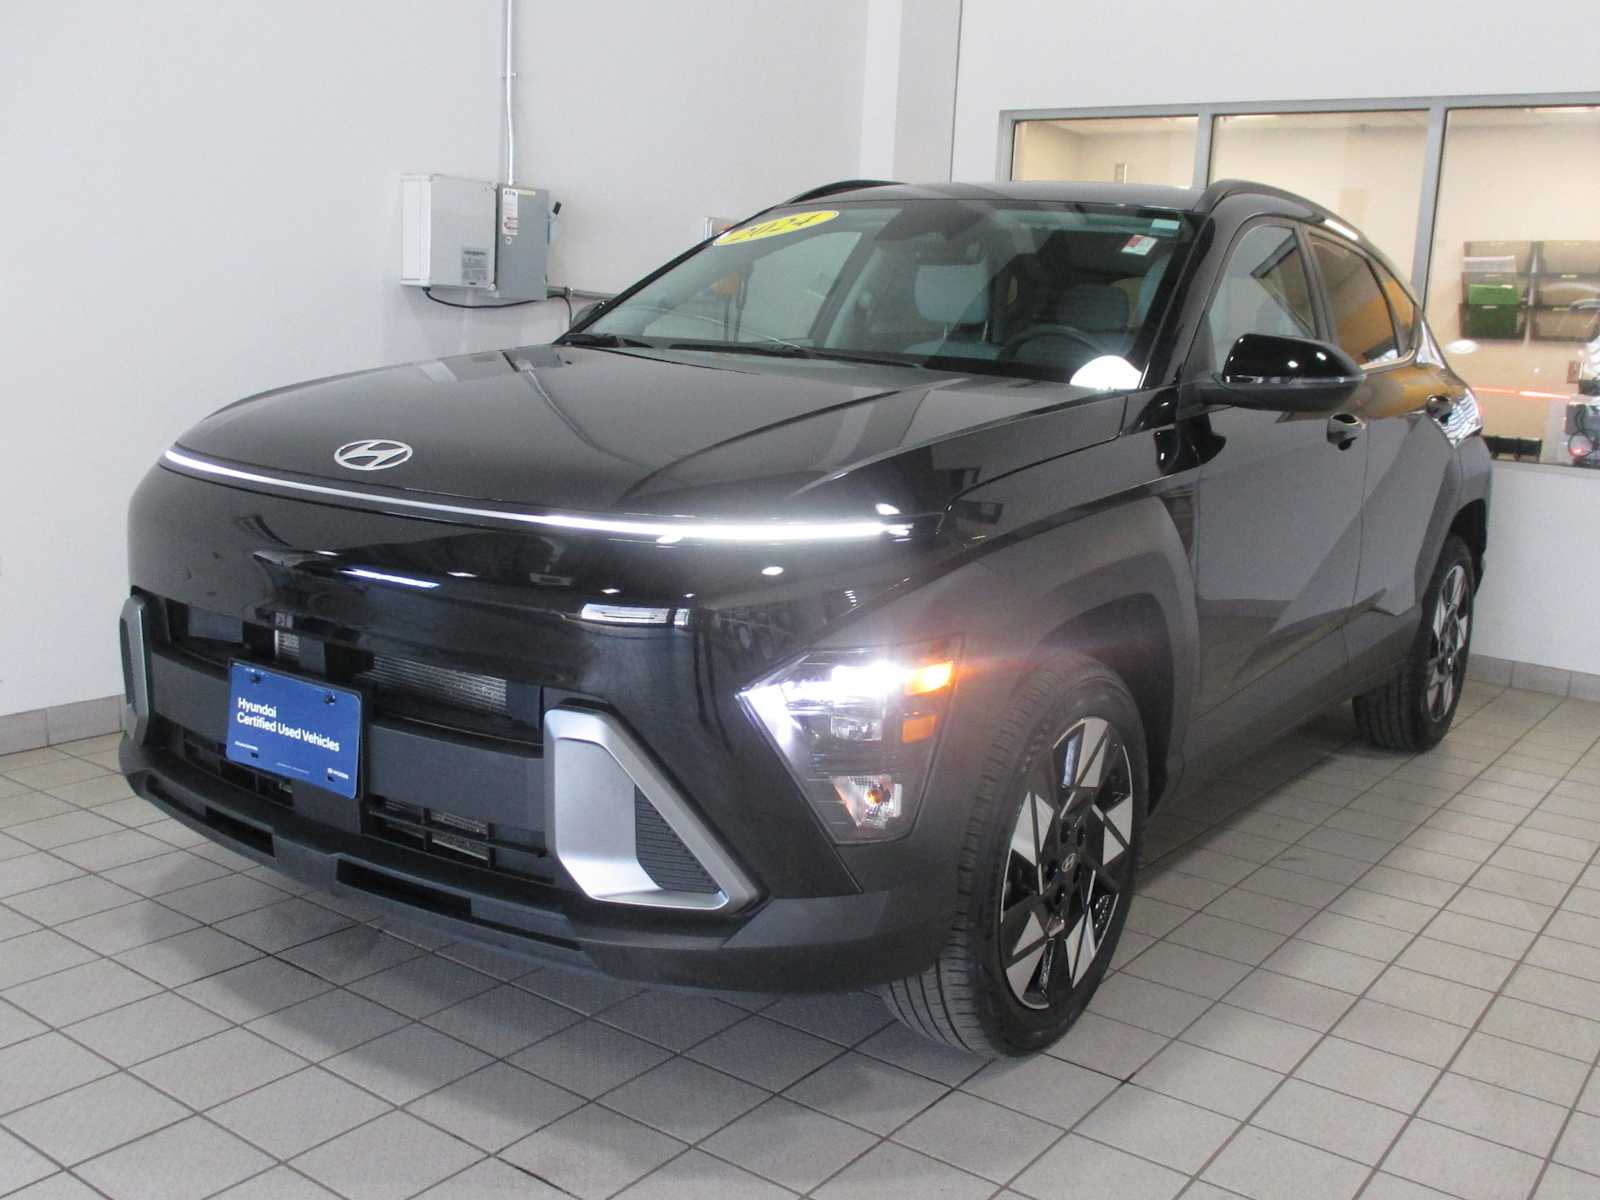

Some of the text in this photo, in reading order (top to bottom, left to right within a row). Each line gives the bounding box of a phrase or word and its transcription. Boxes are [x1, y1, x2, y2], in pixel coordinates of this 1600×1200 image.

[727, 212, 825, 241] 2024
[237, 697, 277, 718] Hyundai
[236, 711, 341, 752] Certified Used Vehicles
